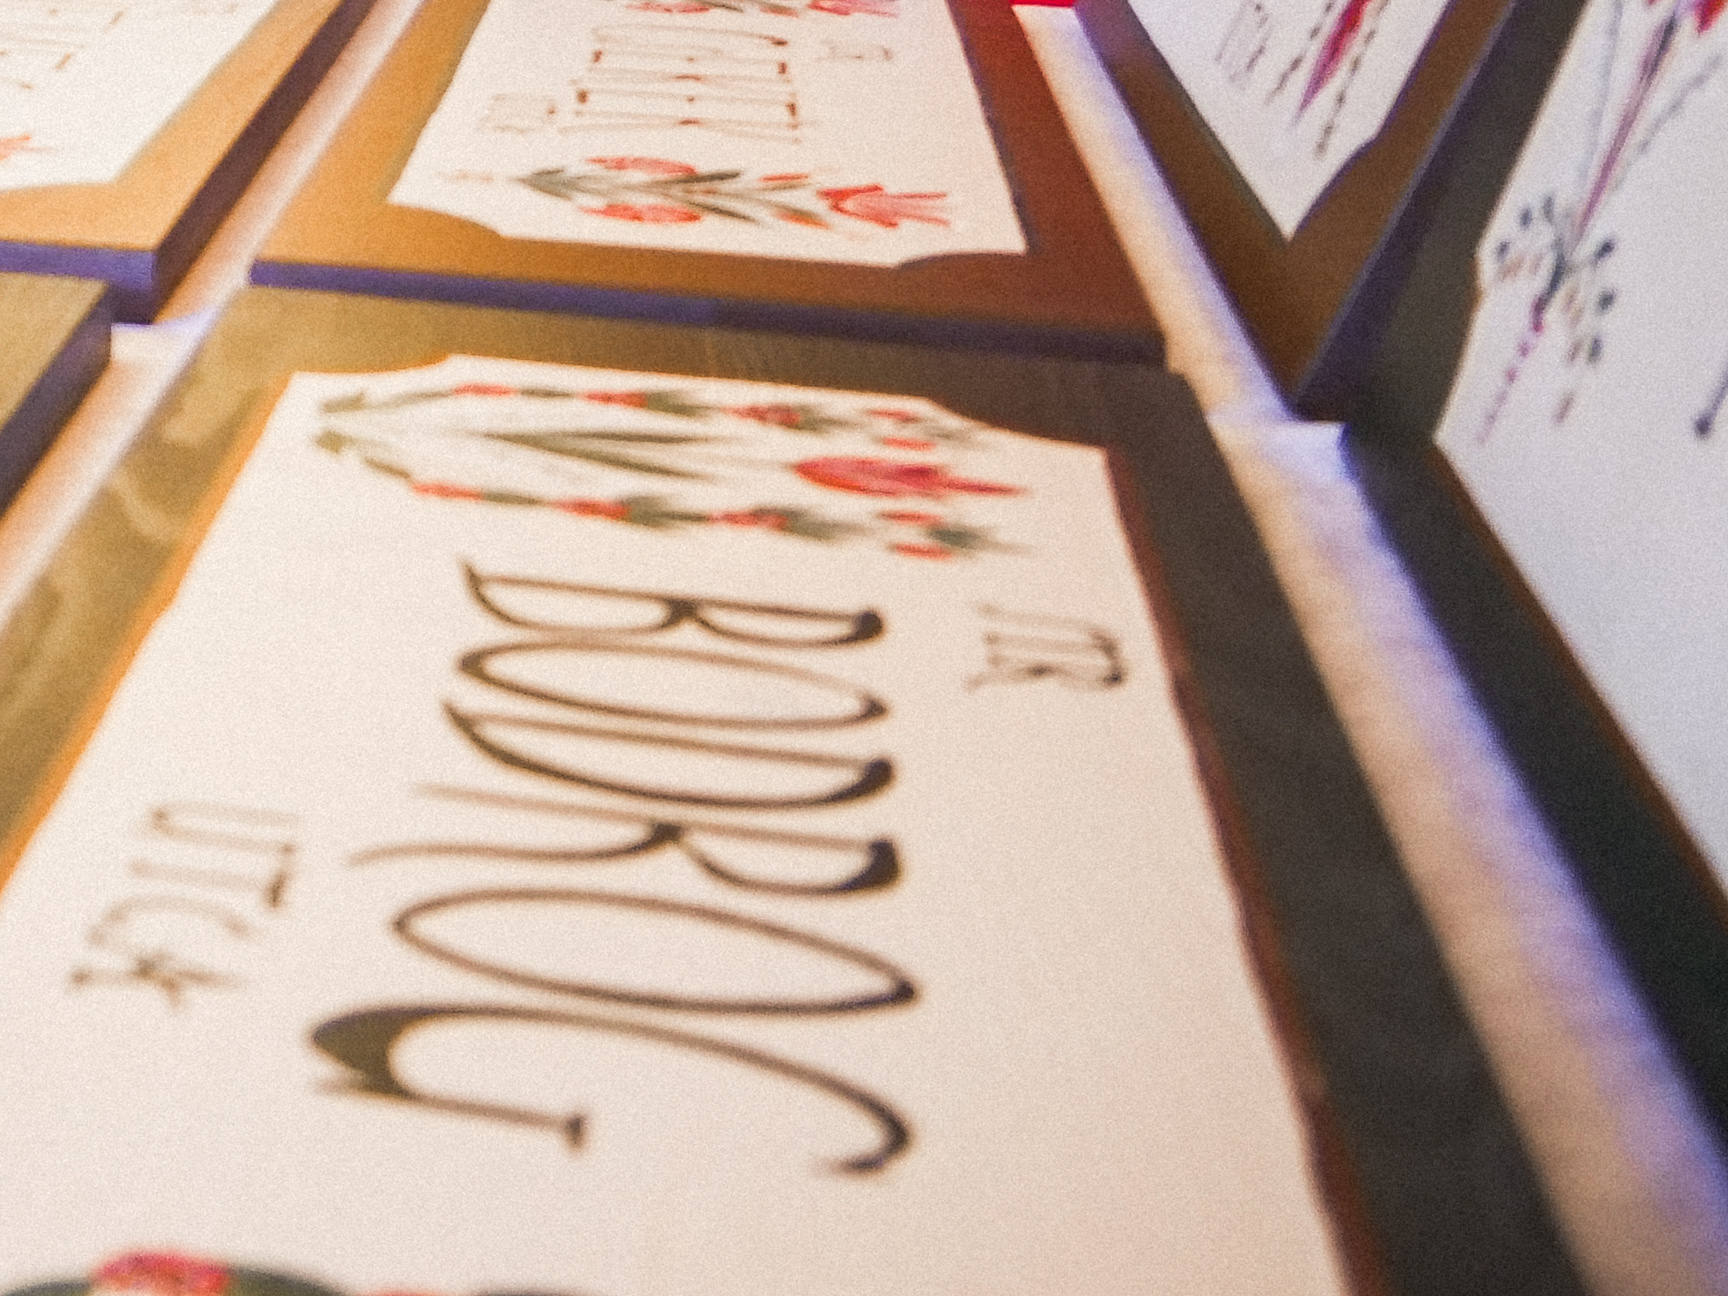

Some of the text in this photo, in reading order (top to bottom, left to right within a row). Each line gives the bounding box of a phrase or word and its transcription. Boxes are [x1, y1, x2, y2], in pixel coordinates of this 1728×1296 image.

[964, 600, 1132, 696] STR
[69, 799, 317, 1019] UTCA
[306, 556, 926, 1178] BODROG
